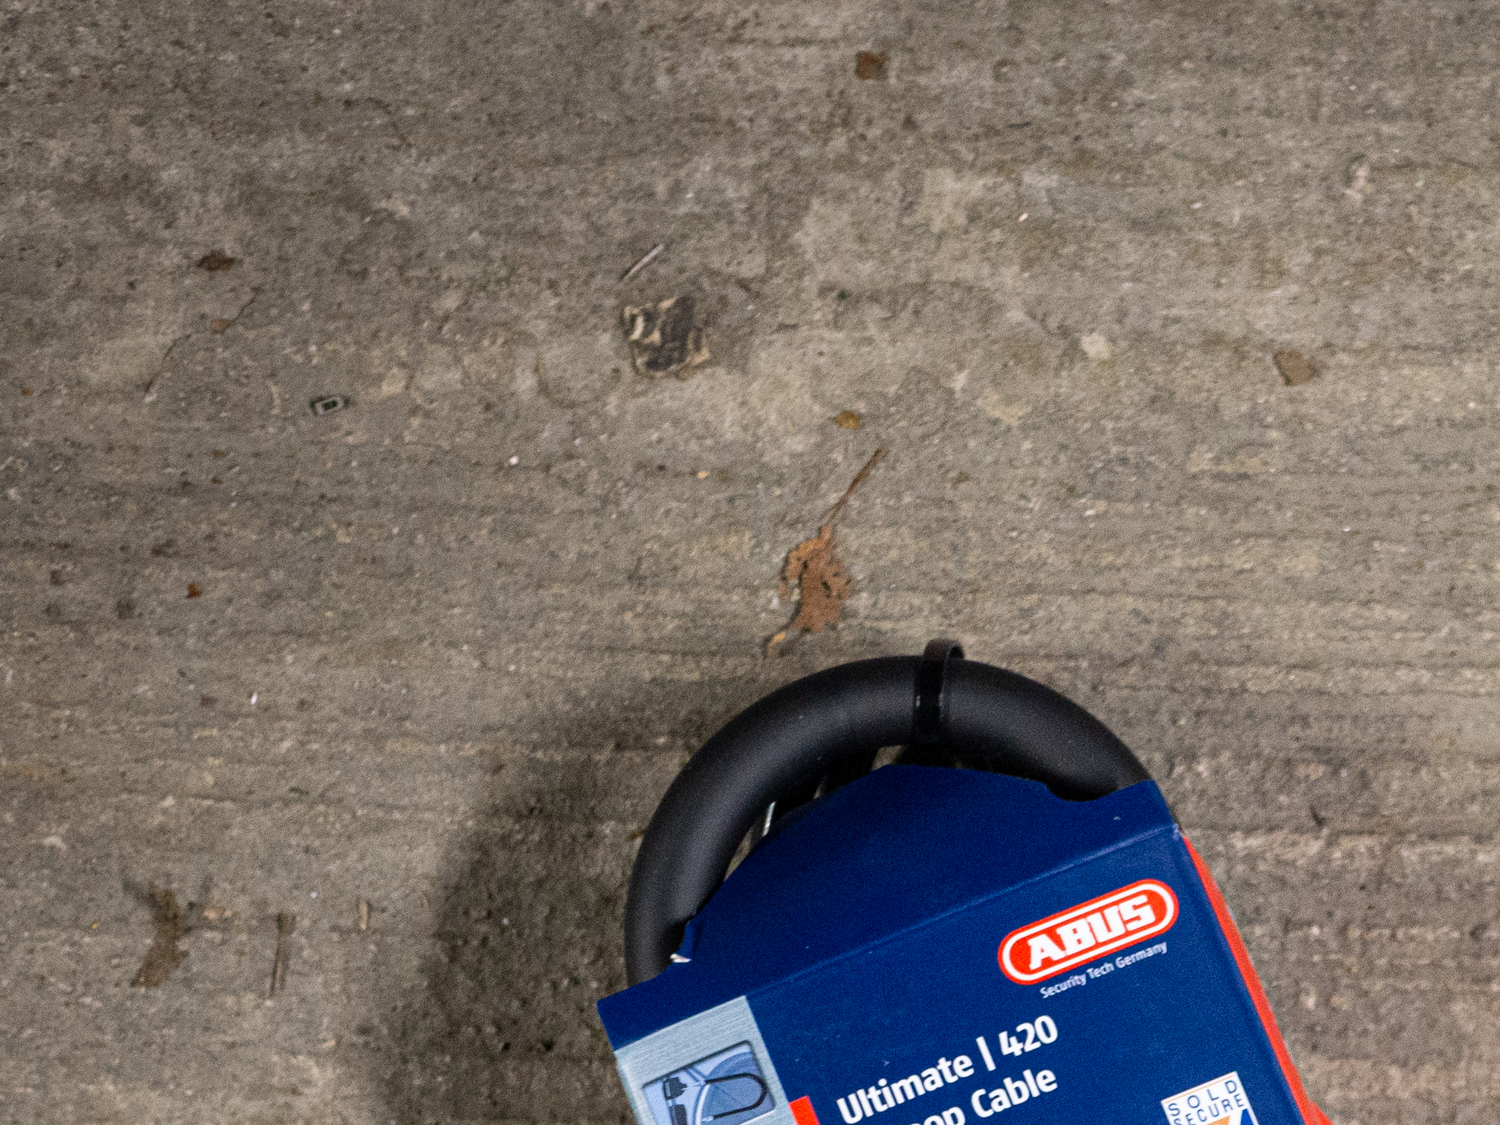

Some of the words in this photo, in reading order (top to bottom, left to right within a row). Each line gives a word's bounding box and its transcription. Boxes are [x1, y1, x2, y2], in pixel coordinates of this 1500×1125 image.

[1027, 894, 1156, 970] ABUS
[1040, 973, 1086, 998] Security
[1087, 963, 1114, 979] Tech
[1116, 942, 1168, 968] Germany
[836, 1055, 974, 1124] Ultimate
[999, 1015, 1058, 1056] 420
[971, 1069, 1058, 1118] Cable
[1167, 1080, 1237, 1117] SOLD
